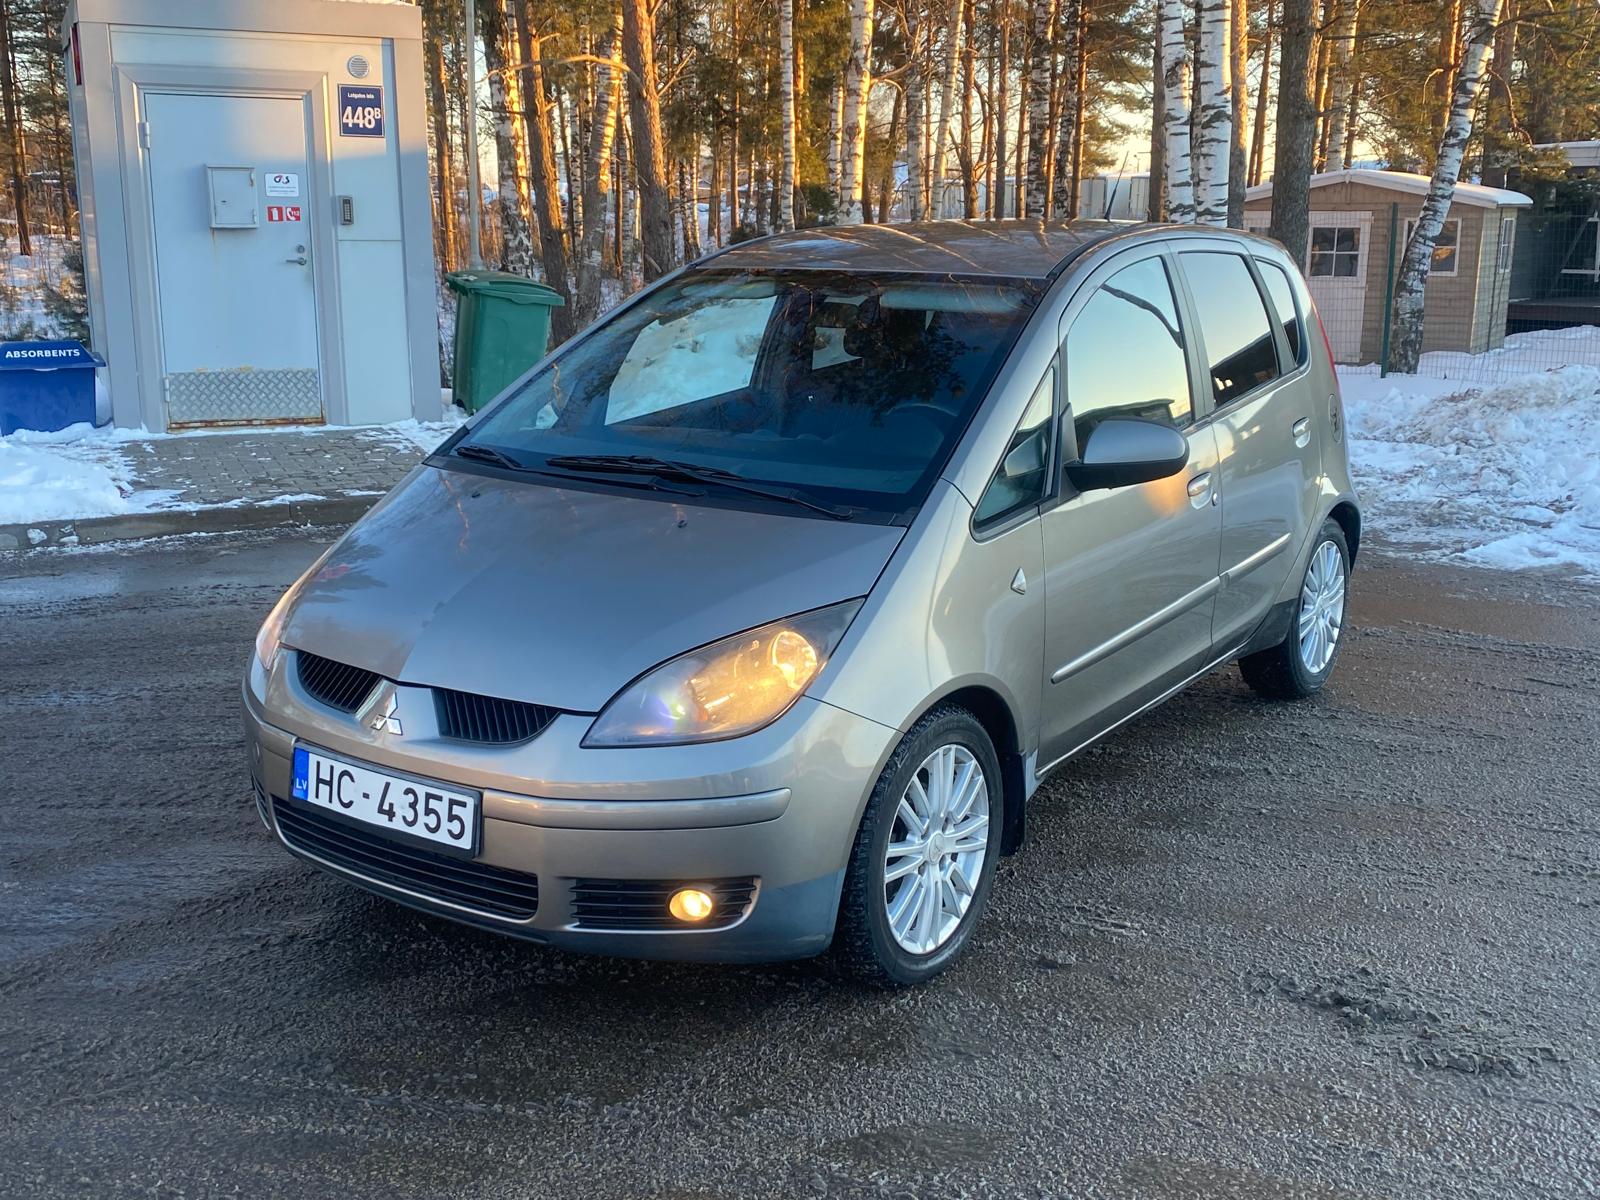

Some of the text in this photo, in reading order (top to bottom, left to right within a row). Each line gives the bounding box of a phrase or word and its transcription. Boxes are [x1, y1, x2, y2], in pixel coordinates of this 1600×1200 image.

[342, 106, 381, 129] 448B
[5, 349, 80, 358] ABSORBENTS
[295, 777, 307, 790] LV
[315, 760, 468, 840] HC-4355
